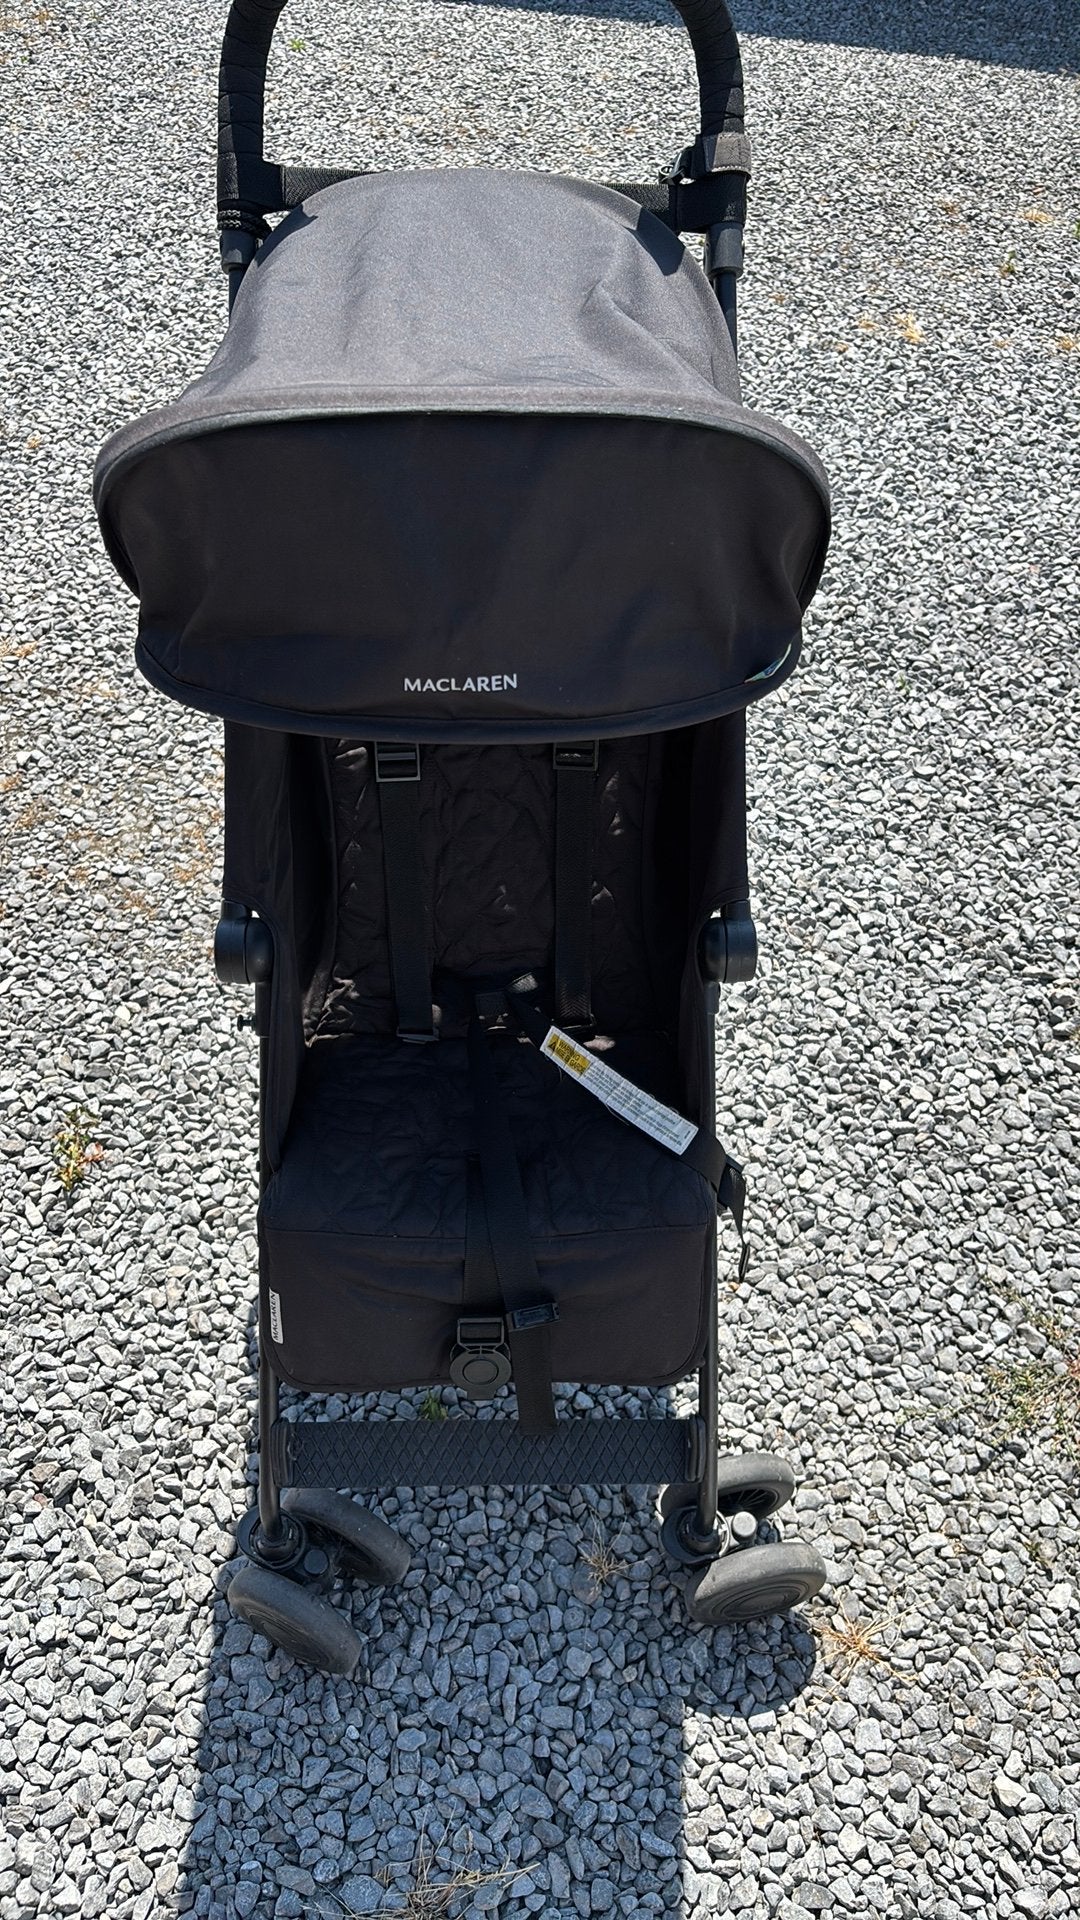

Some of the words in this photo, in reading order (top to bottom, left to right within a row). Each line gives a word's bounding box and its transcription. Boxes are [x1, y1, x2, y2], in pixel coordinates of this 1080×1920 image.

[403, 673, 518, 692] MACLAREN
[557, 1040, 581, 1062] WARNING
[270, 1291, 279, 1341] MACLAREN
